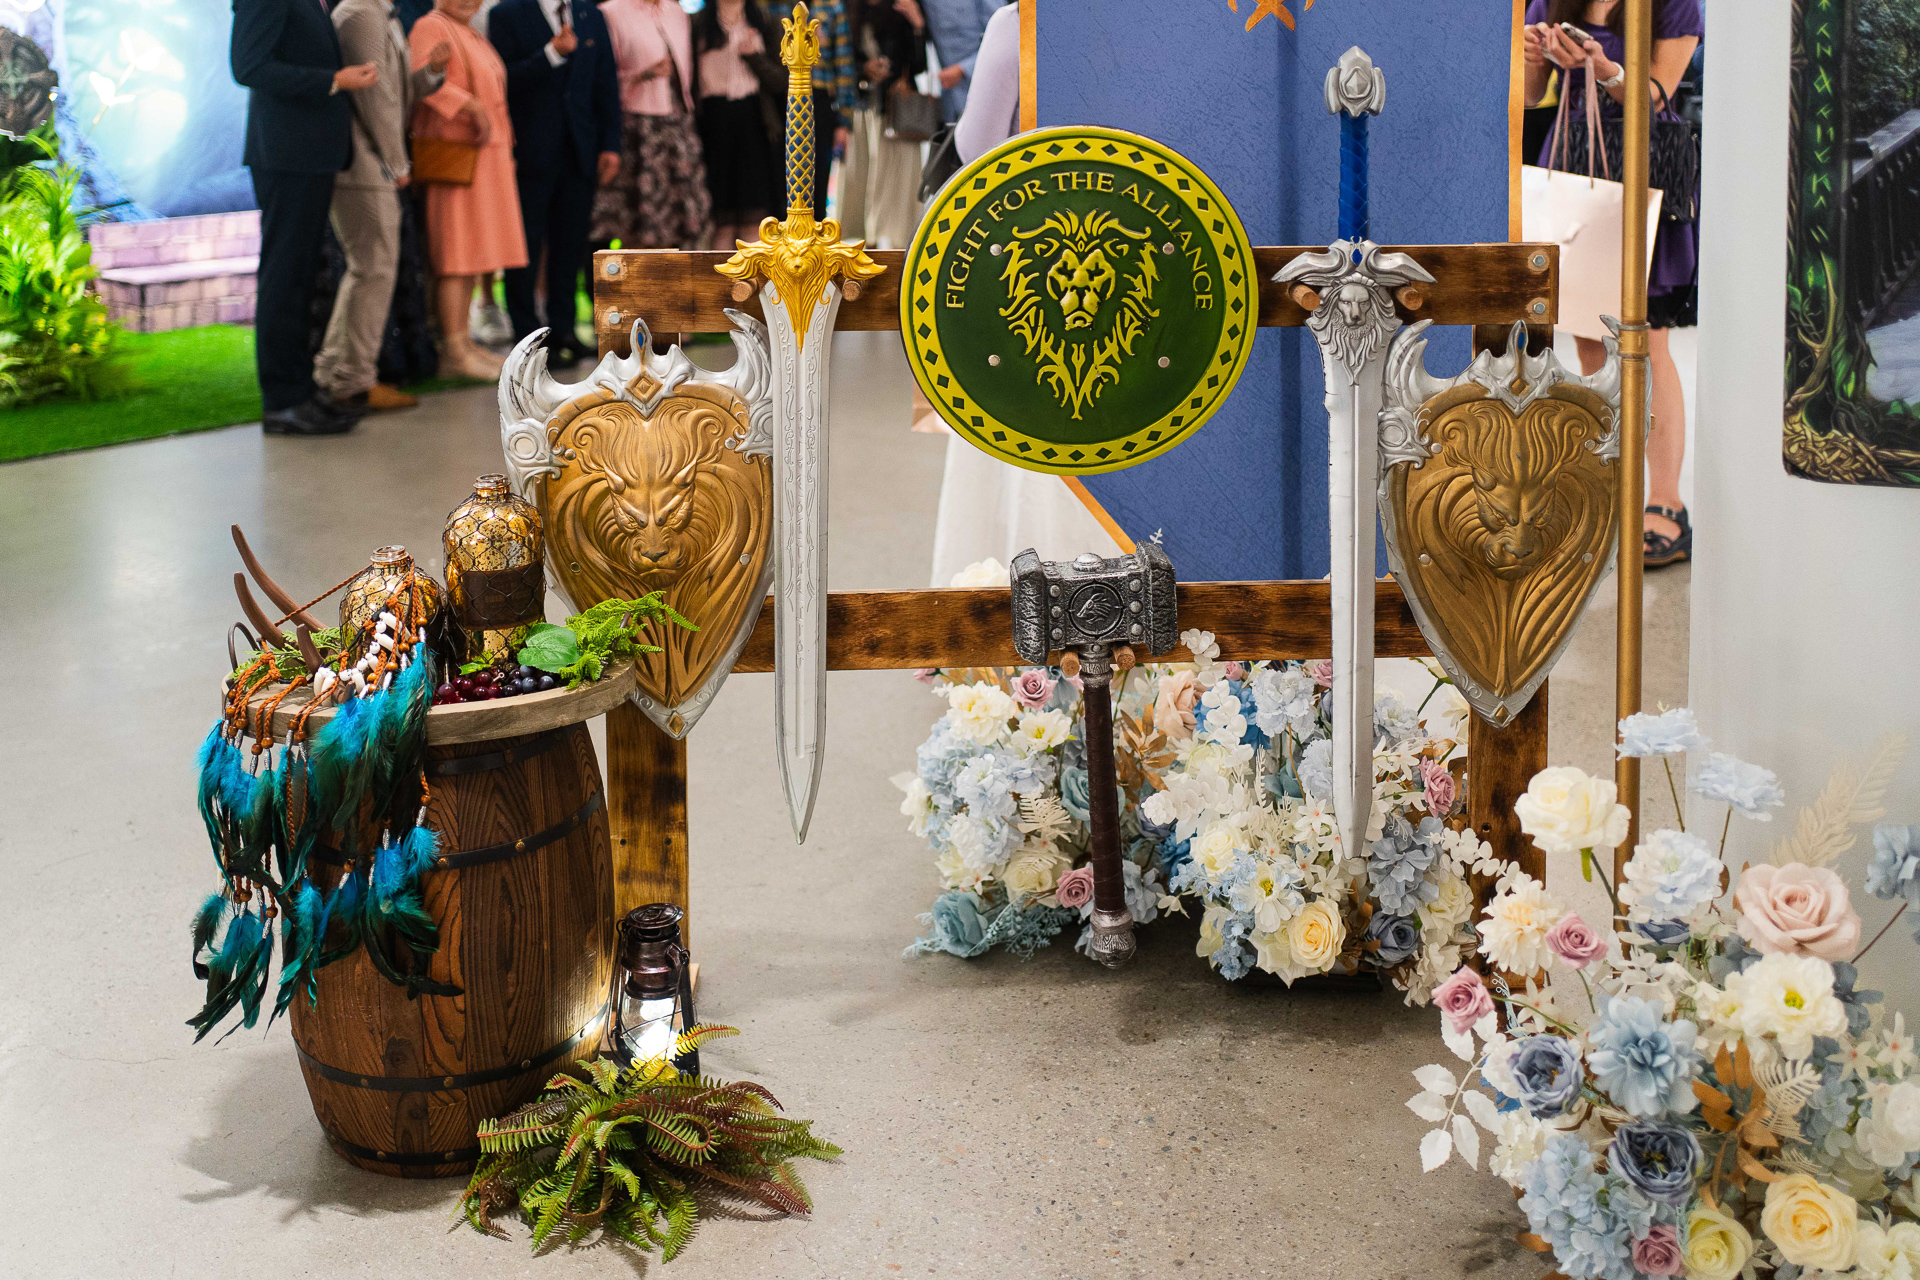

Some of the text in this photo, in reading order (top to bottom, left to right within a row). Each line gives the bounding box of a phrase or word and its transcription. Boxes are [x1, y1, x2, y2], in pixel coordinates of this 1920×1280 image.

[946, 171, 1214, 310] FIGHT FOR THE ALLIANCE
